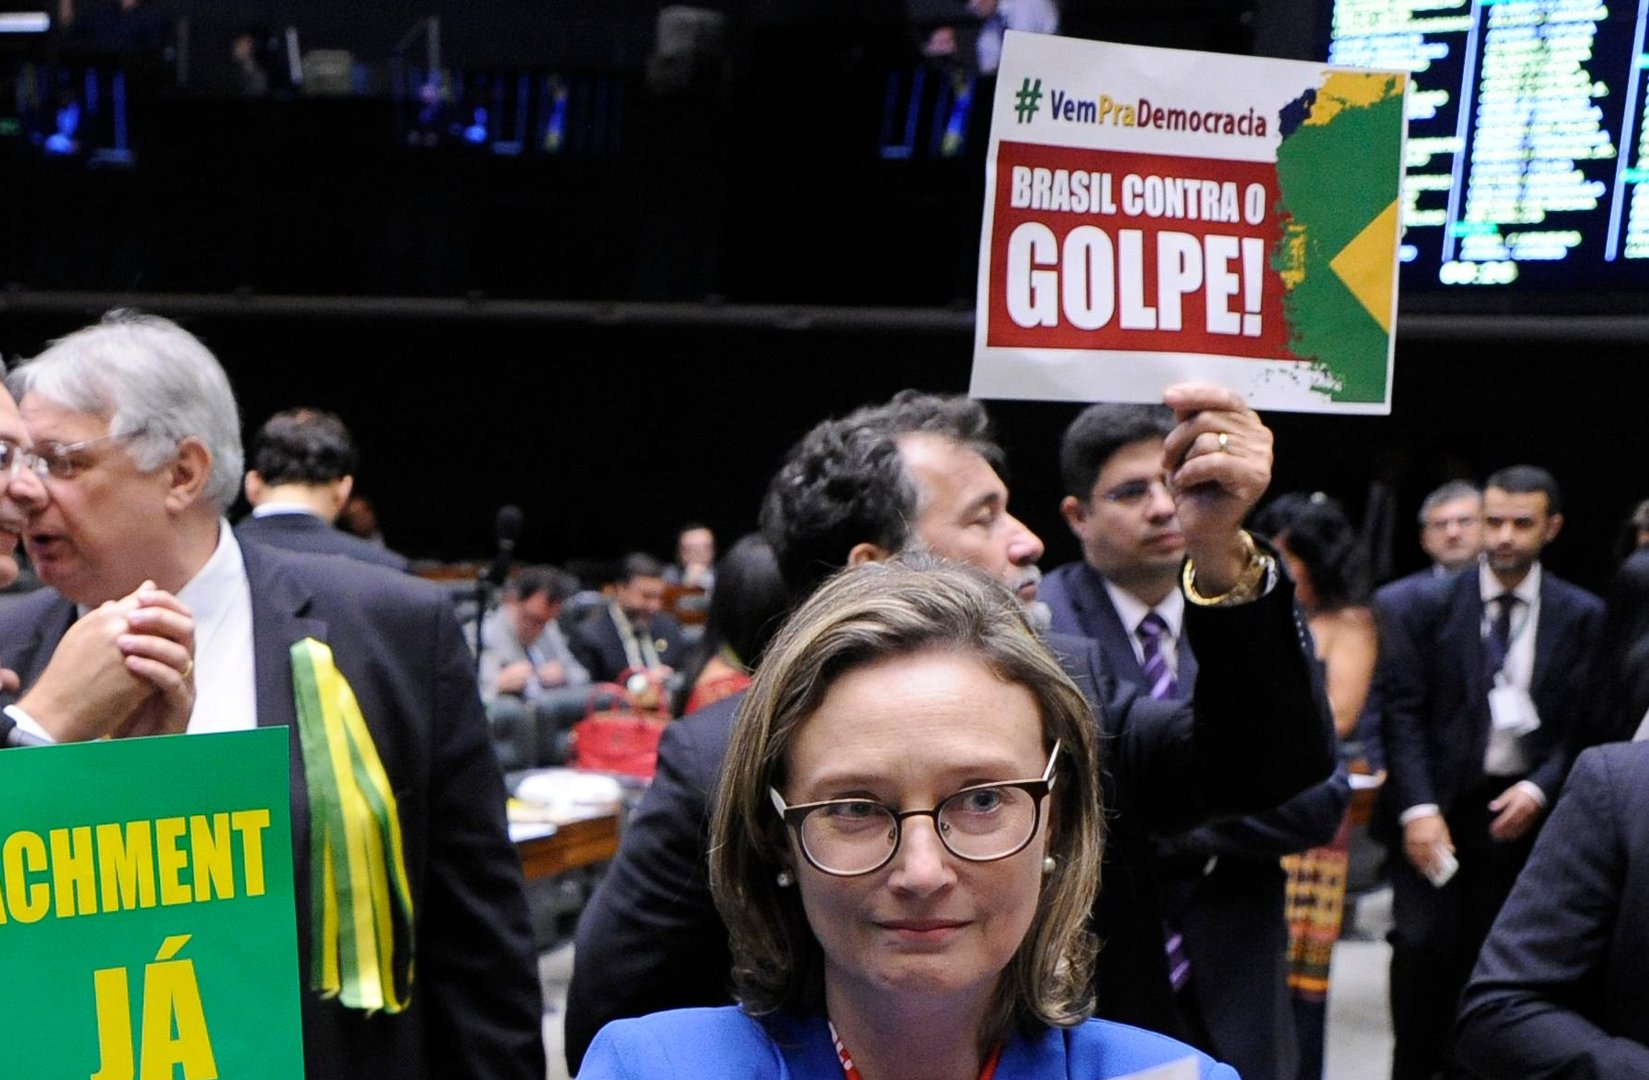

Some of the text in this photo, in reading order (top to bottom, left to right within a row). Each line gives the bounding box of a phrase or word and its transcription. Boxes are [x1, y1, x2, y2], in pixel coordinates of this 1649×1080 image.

[1011, 165, 1266, 225] BRASIL CONTRA O
[1006, 221, 1264, 337] GOLPE!
